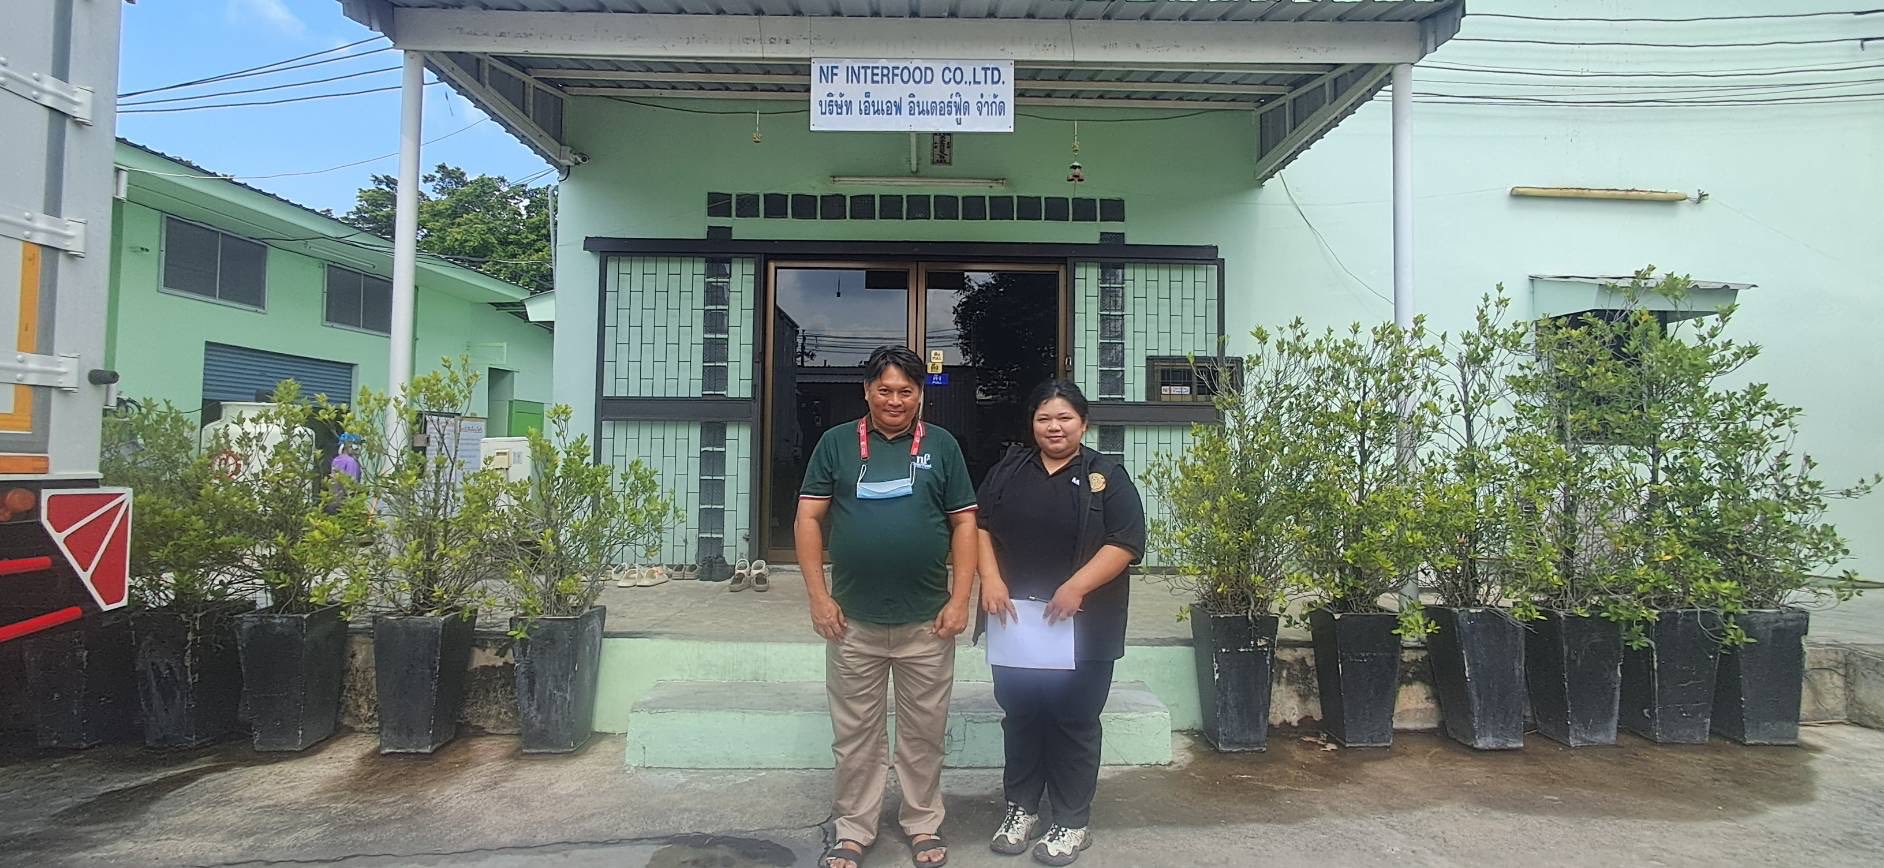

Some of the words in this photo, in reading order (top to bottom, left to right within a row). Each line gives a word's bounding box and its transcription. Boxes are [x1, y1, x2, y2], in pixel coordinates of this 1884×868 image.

[819, 65, 839, 84] NF
[845, 65, 934, 85] INTERFOOD
[941, 66, 1005, 86] CO.,LTD.
[819, 92, 853, 116] บริษัท
[859, 91, 903, 116] เอ็นเอฟ
[976, 92, 1006, 117] จำกัด
